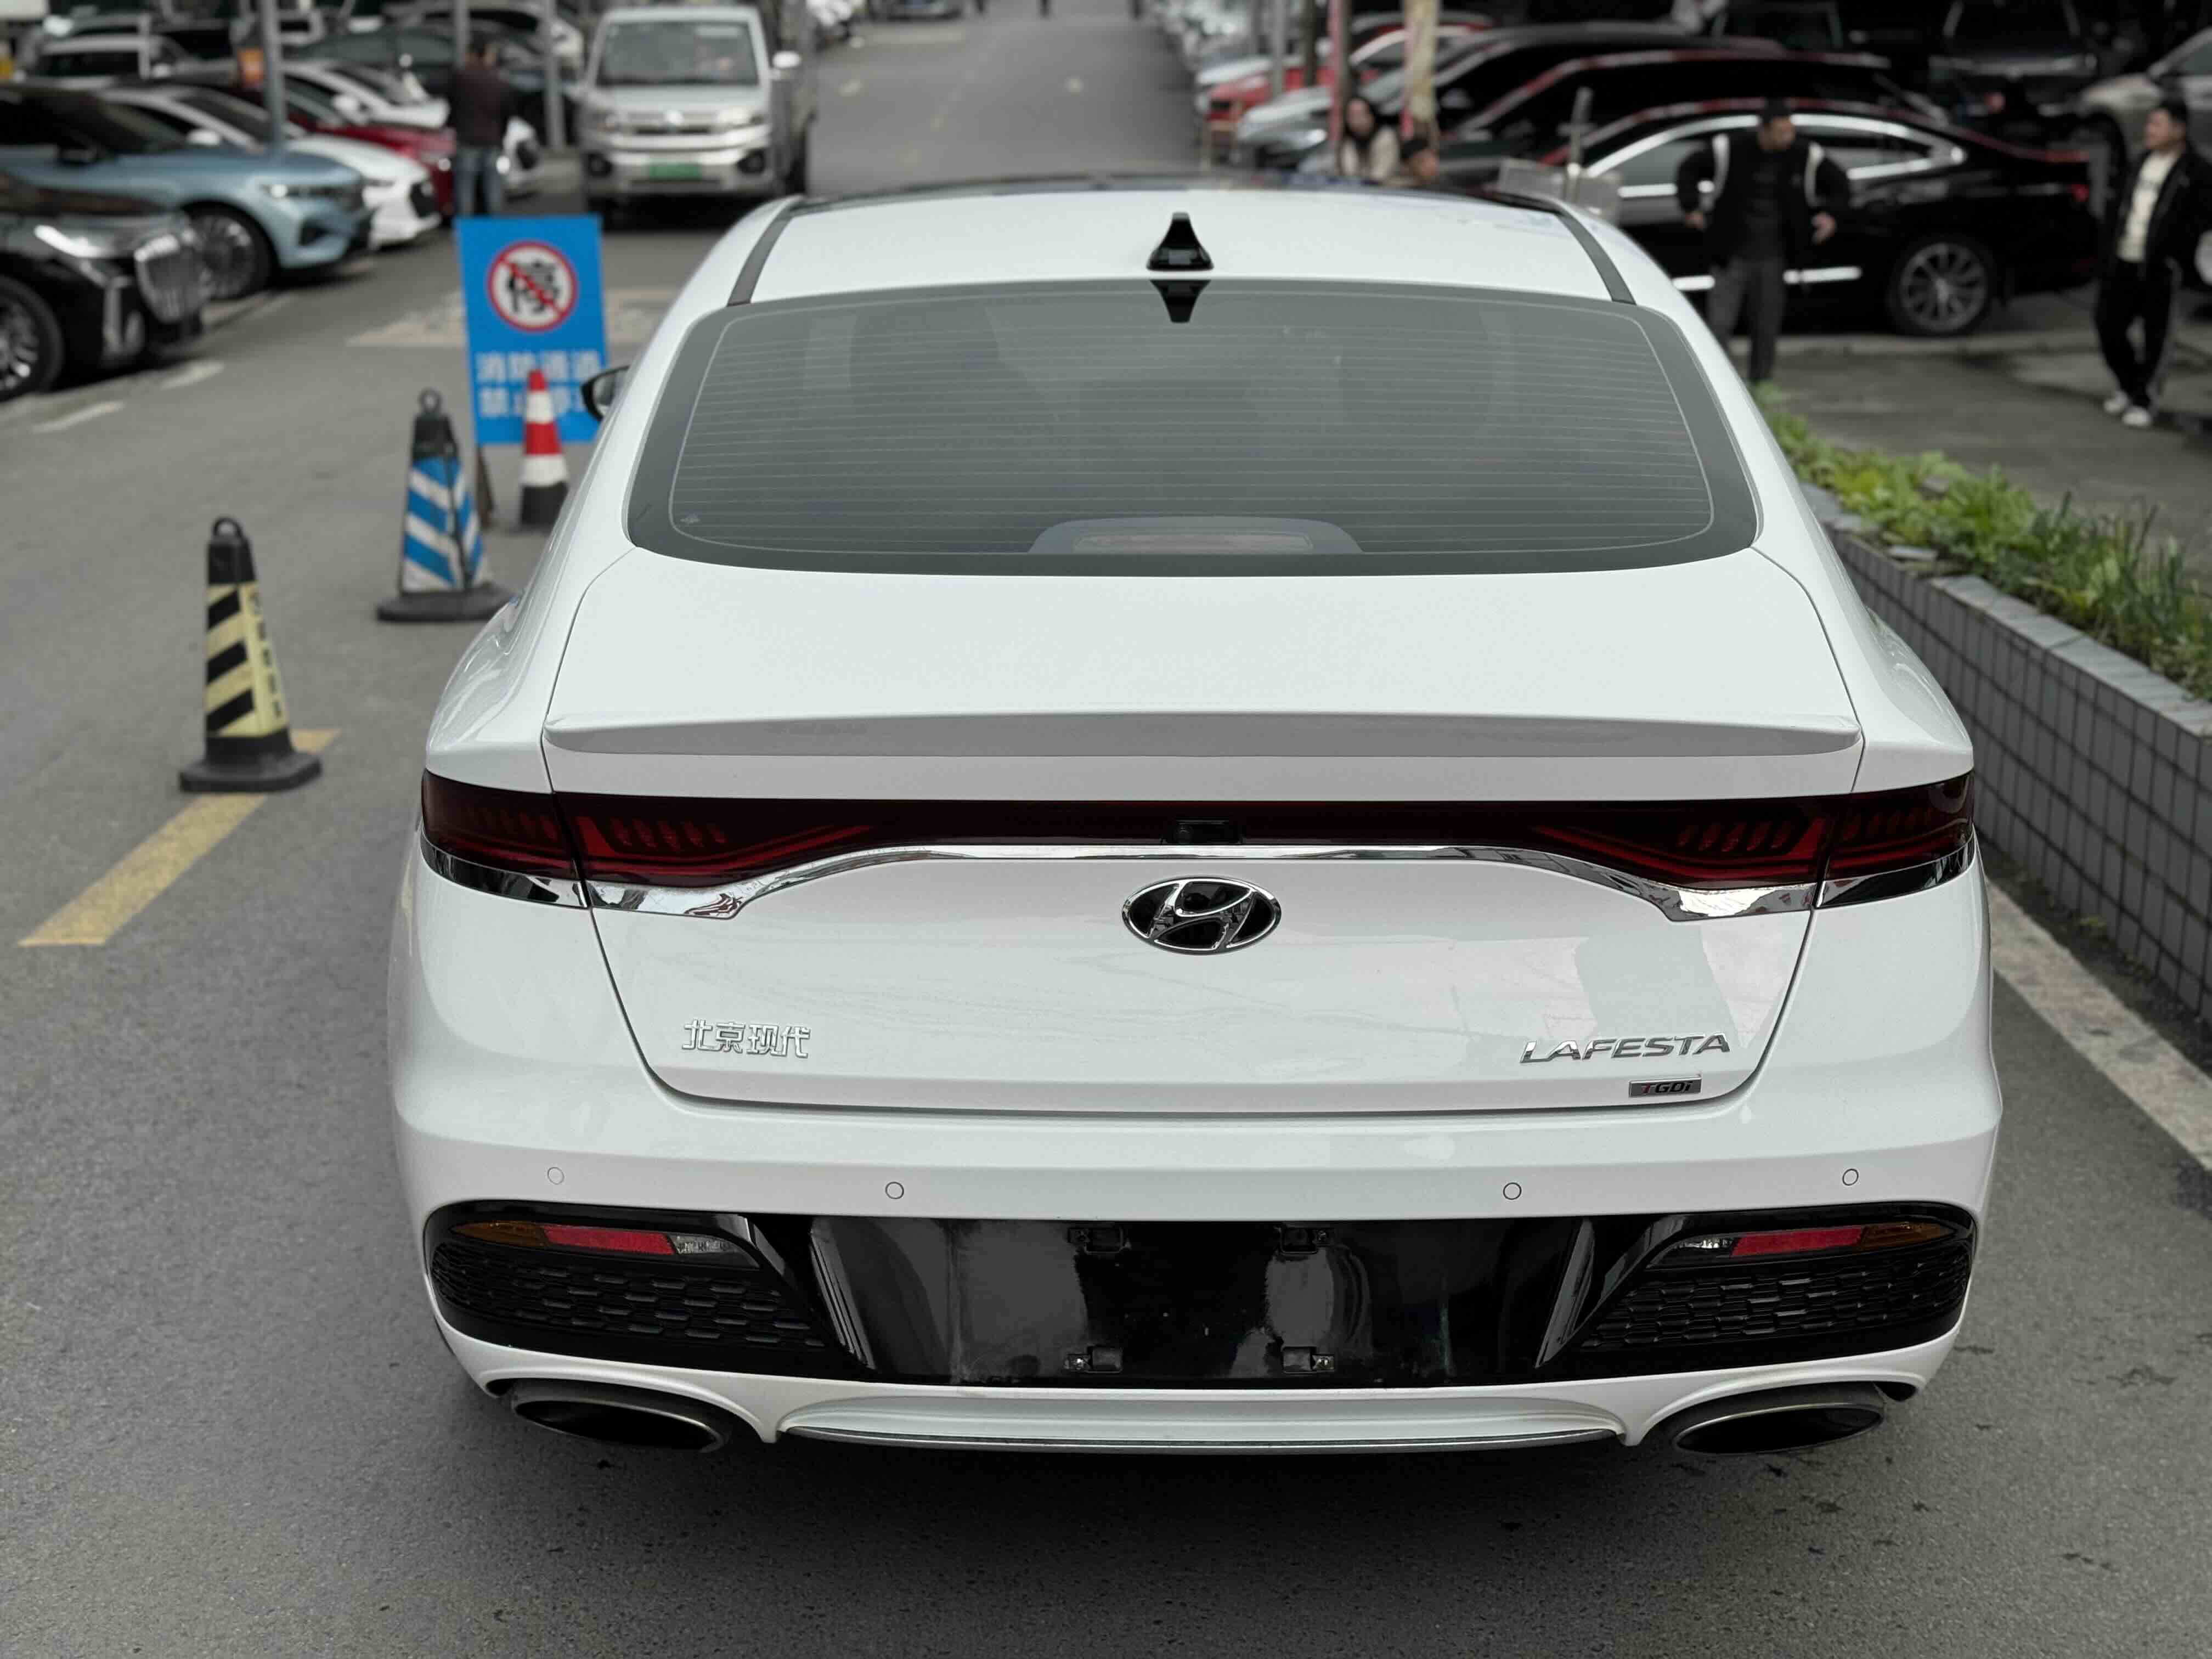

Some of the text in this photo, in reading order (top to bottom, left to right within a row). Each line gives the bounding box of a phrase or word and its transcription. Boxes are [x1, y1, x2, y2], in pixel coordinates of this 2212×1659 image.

[681, 1019, 811, 1058] 北京现代
[1519, 1031, 1731, 1064] LAFESTA
